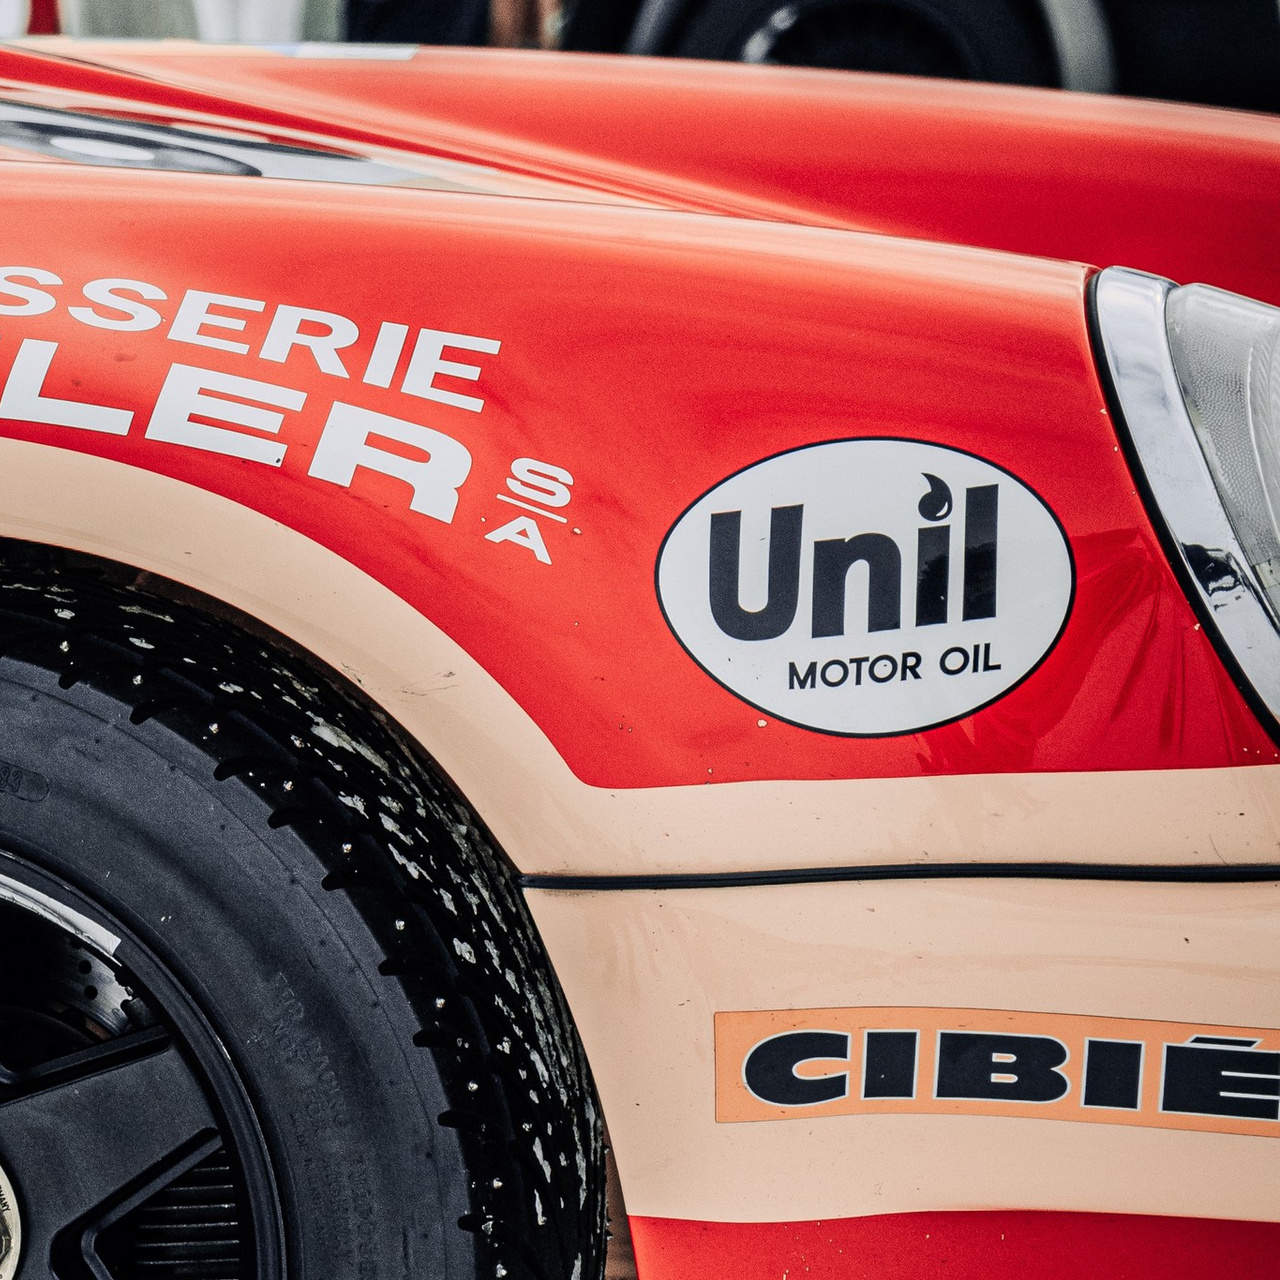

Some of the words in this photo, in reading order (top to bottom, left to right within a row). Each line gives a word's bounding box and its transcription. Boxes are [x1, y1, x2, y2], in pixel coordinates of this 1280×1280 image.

[709, 472, 1000, 641] Unil
[788, 651, 923, 690] MOTOR
[939, 642, 1002, 676] OIL
[742, 1028, 1280, 1122] CIBIÉ
